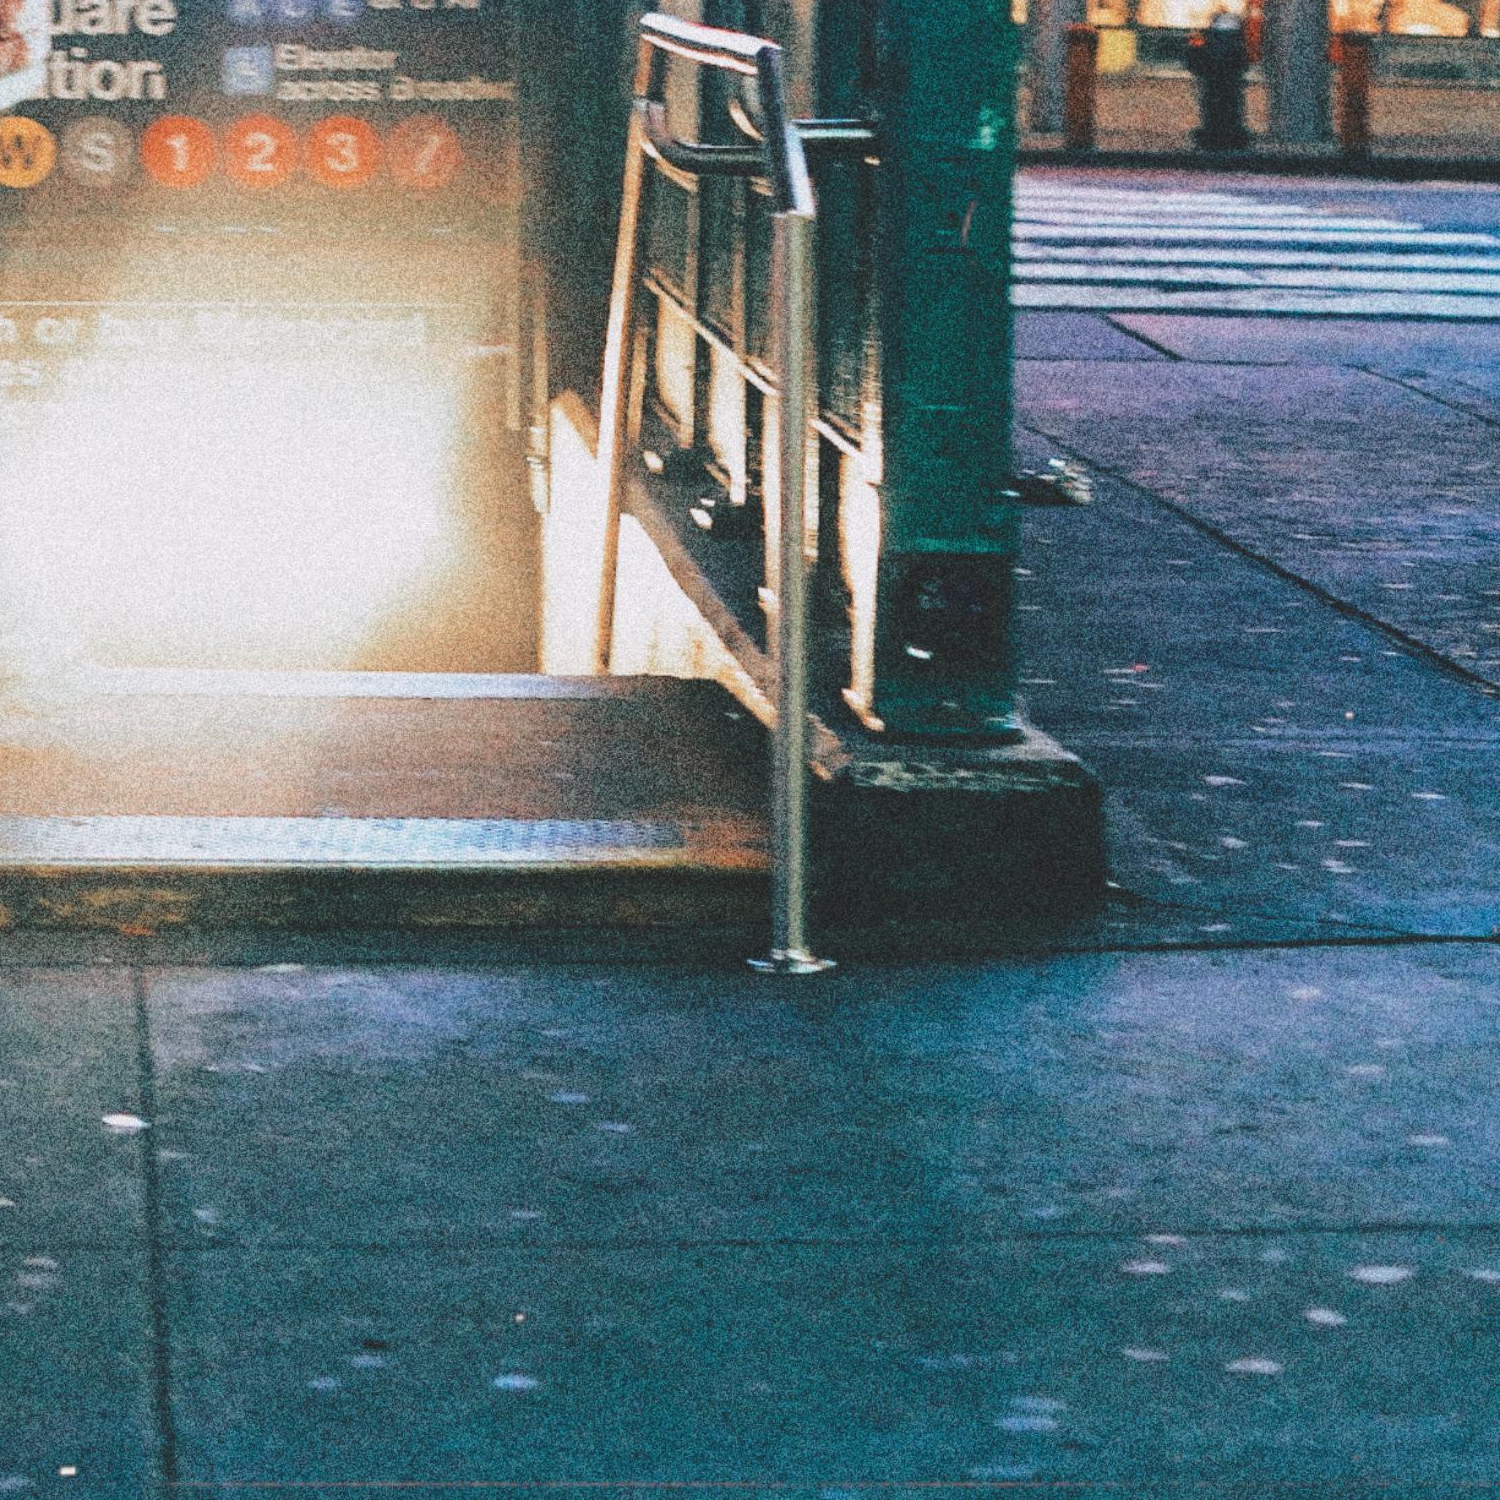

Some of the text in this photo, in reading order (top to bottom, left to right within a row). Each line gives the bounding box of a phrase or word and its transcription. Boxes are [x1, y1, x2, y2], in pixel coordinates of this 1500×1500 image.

[46, 46, 168, 100] tion
[83, 132, 114, 173] S
[244, 133, 275, 173] 2
[326, 132, 359, 173] 3
